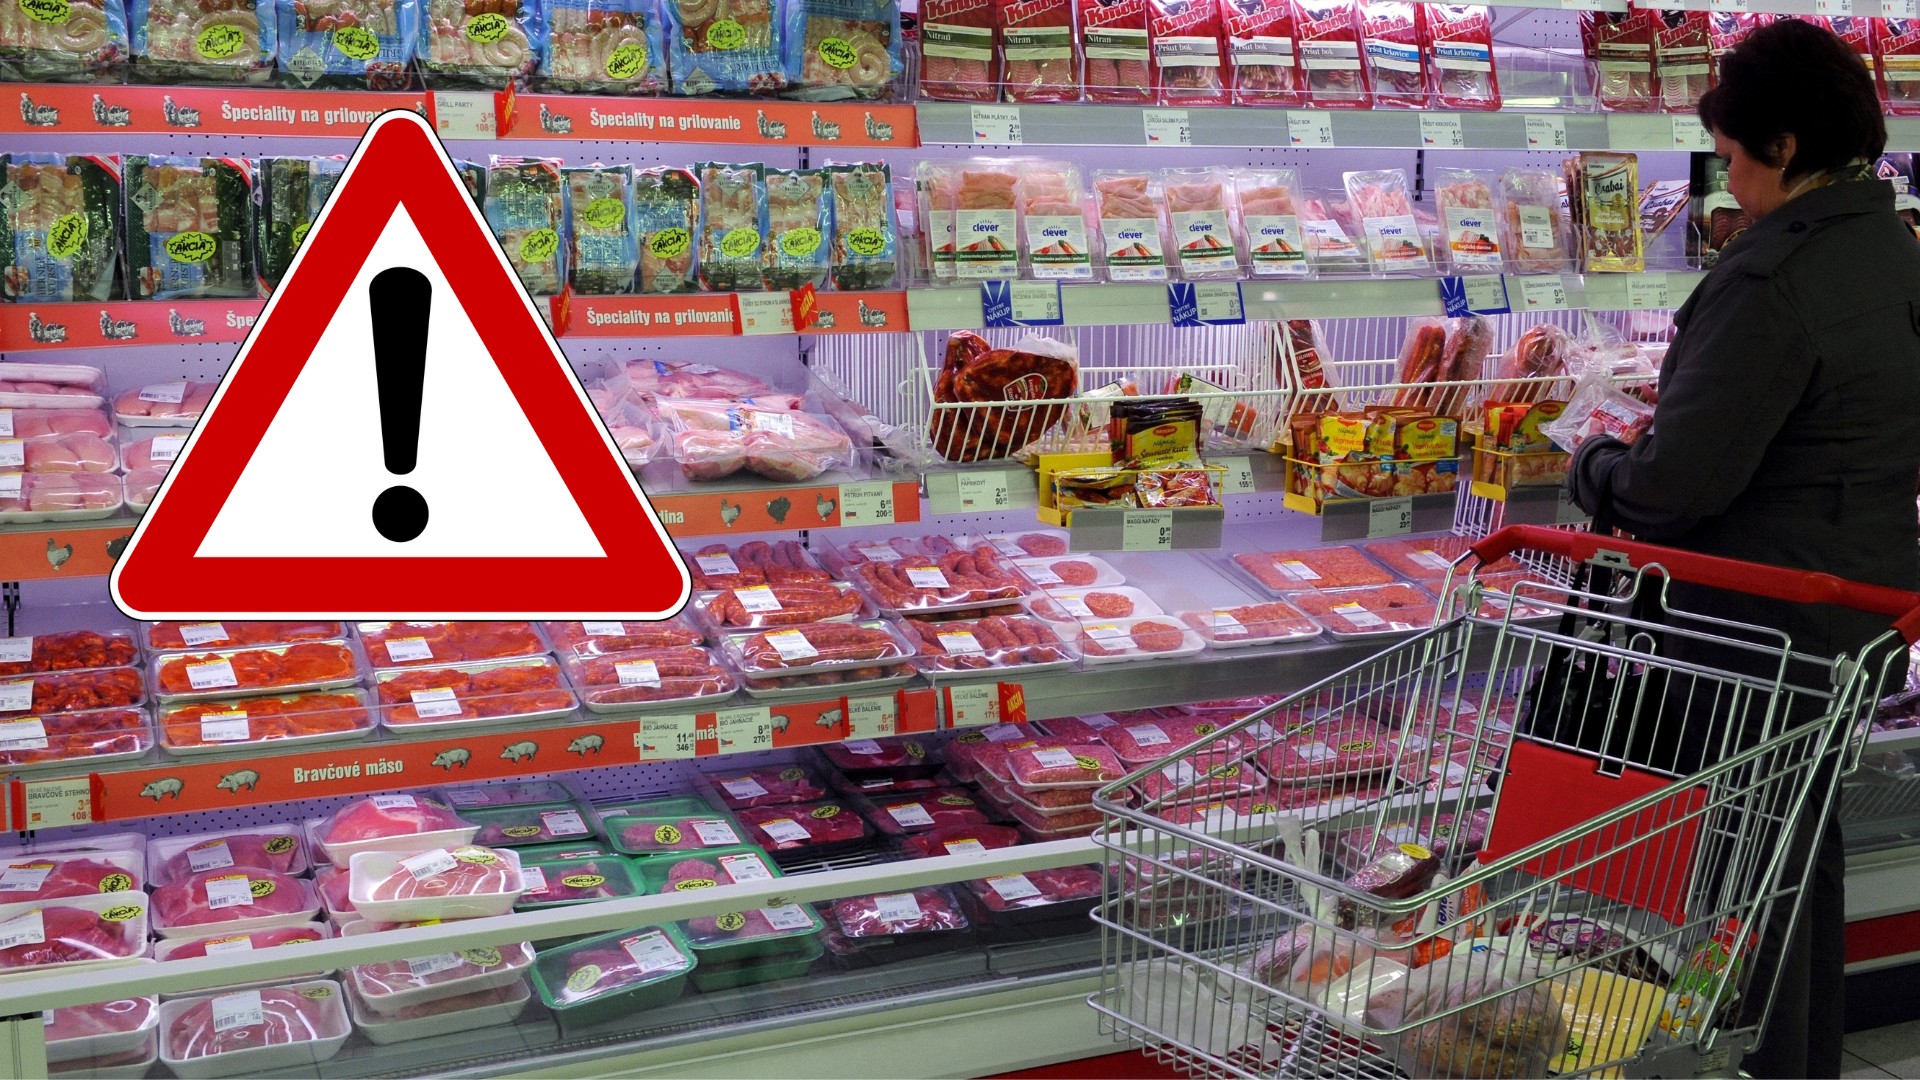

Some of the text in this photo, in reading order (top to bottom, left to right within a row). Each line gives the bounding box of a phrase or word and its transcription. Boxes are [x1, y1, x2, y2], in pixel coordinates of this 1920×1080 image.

[1085, 0, 1144, 27] Kmotr
[1153, 5, 1210, 36] Kmotr
[1230, 6, 1286, 35] Kmotr
[1301, 11, 1352, 41] Kmotr
[1433, 14, 1483, 41] Kmotr
[1657, 17, 1704, 48] Kmotr
[926, 30, 951, 41] Nitran
[1008, 35, 1031, 44] Nitran
[1088, 34, 1112, 44] Nitran
[1179, 43, 1192, 51] bok
[1320, 47, 1334, 55] bok
[1436, 47, 1480, 58] Pršut krkovice
[222, 100, 384, 125] Špeciality na grilovan
[590, 107, 741, 131] Špeciality na grilovanie
[972, 222, 1000, 233] clever
[1189, 223, 1213, 233] clever
[1459, 219, 1482, 228] clever
[1042, 228, 1068, 237] clever
[1118, 231, 1143, 240] clever
[1260, 227, 1285, 236] clever
[1447, 299, 1466, 312] NÁKUP
[587, 306, 652, 327] Špeciality
[655, 311, 672, 324] na
[986, 307, 1011, 322] NÁKUP
[1173, 307, 1197, 323] NÁKUP
[864, 489, 883, 497] PITVANÝ
[659, 508, 684, 526] dina
[696, 725, 717, 741] mä
[294, 759, 404, 784] Bravčové mäso
[28, 788, 89, 800] BRAVČOVÉ STEHNO
